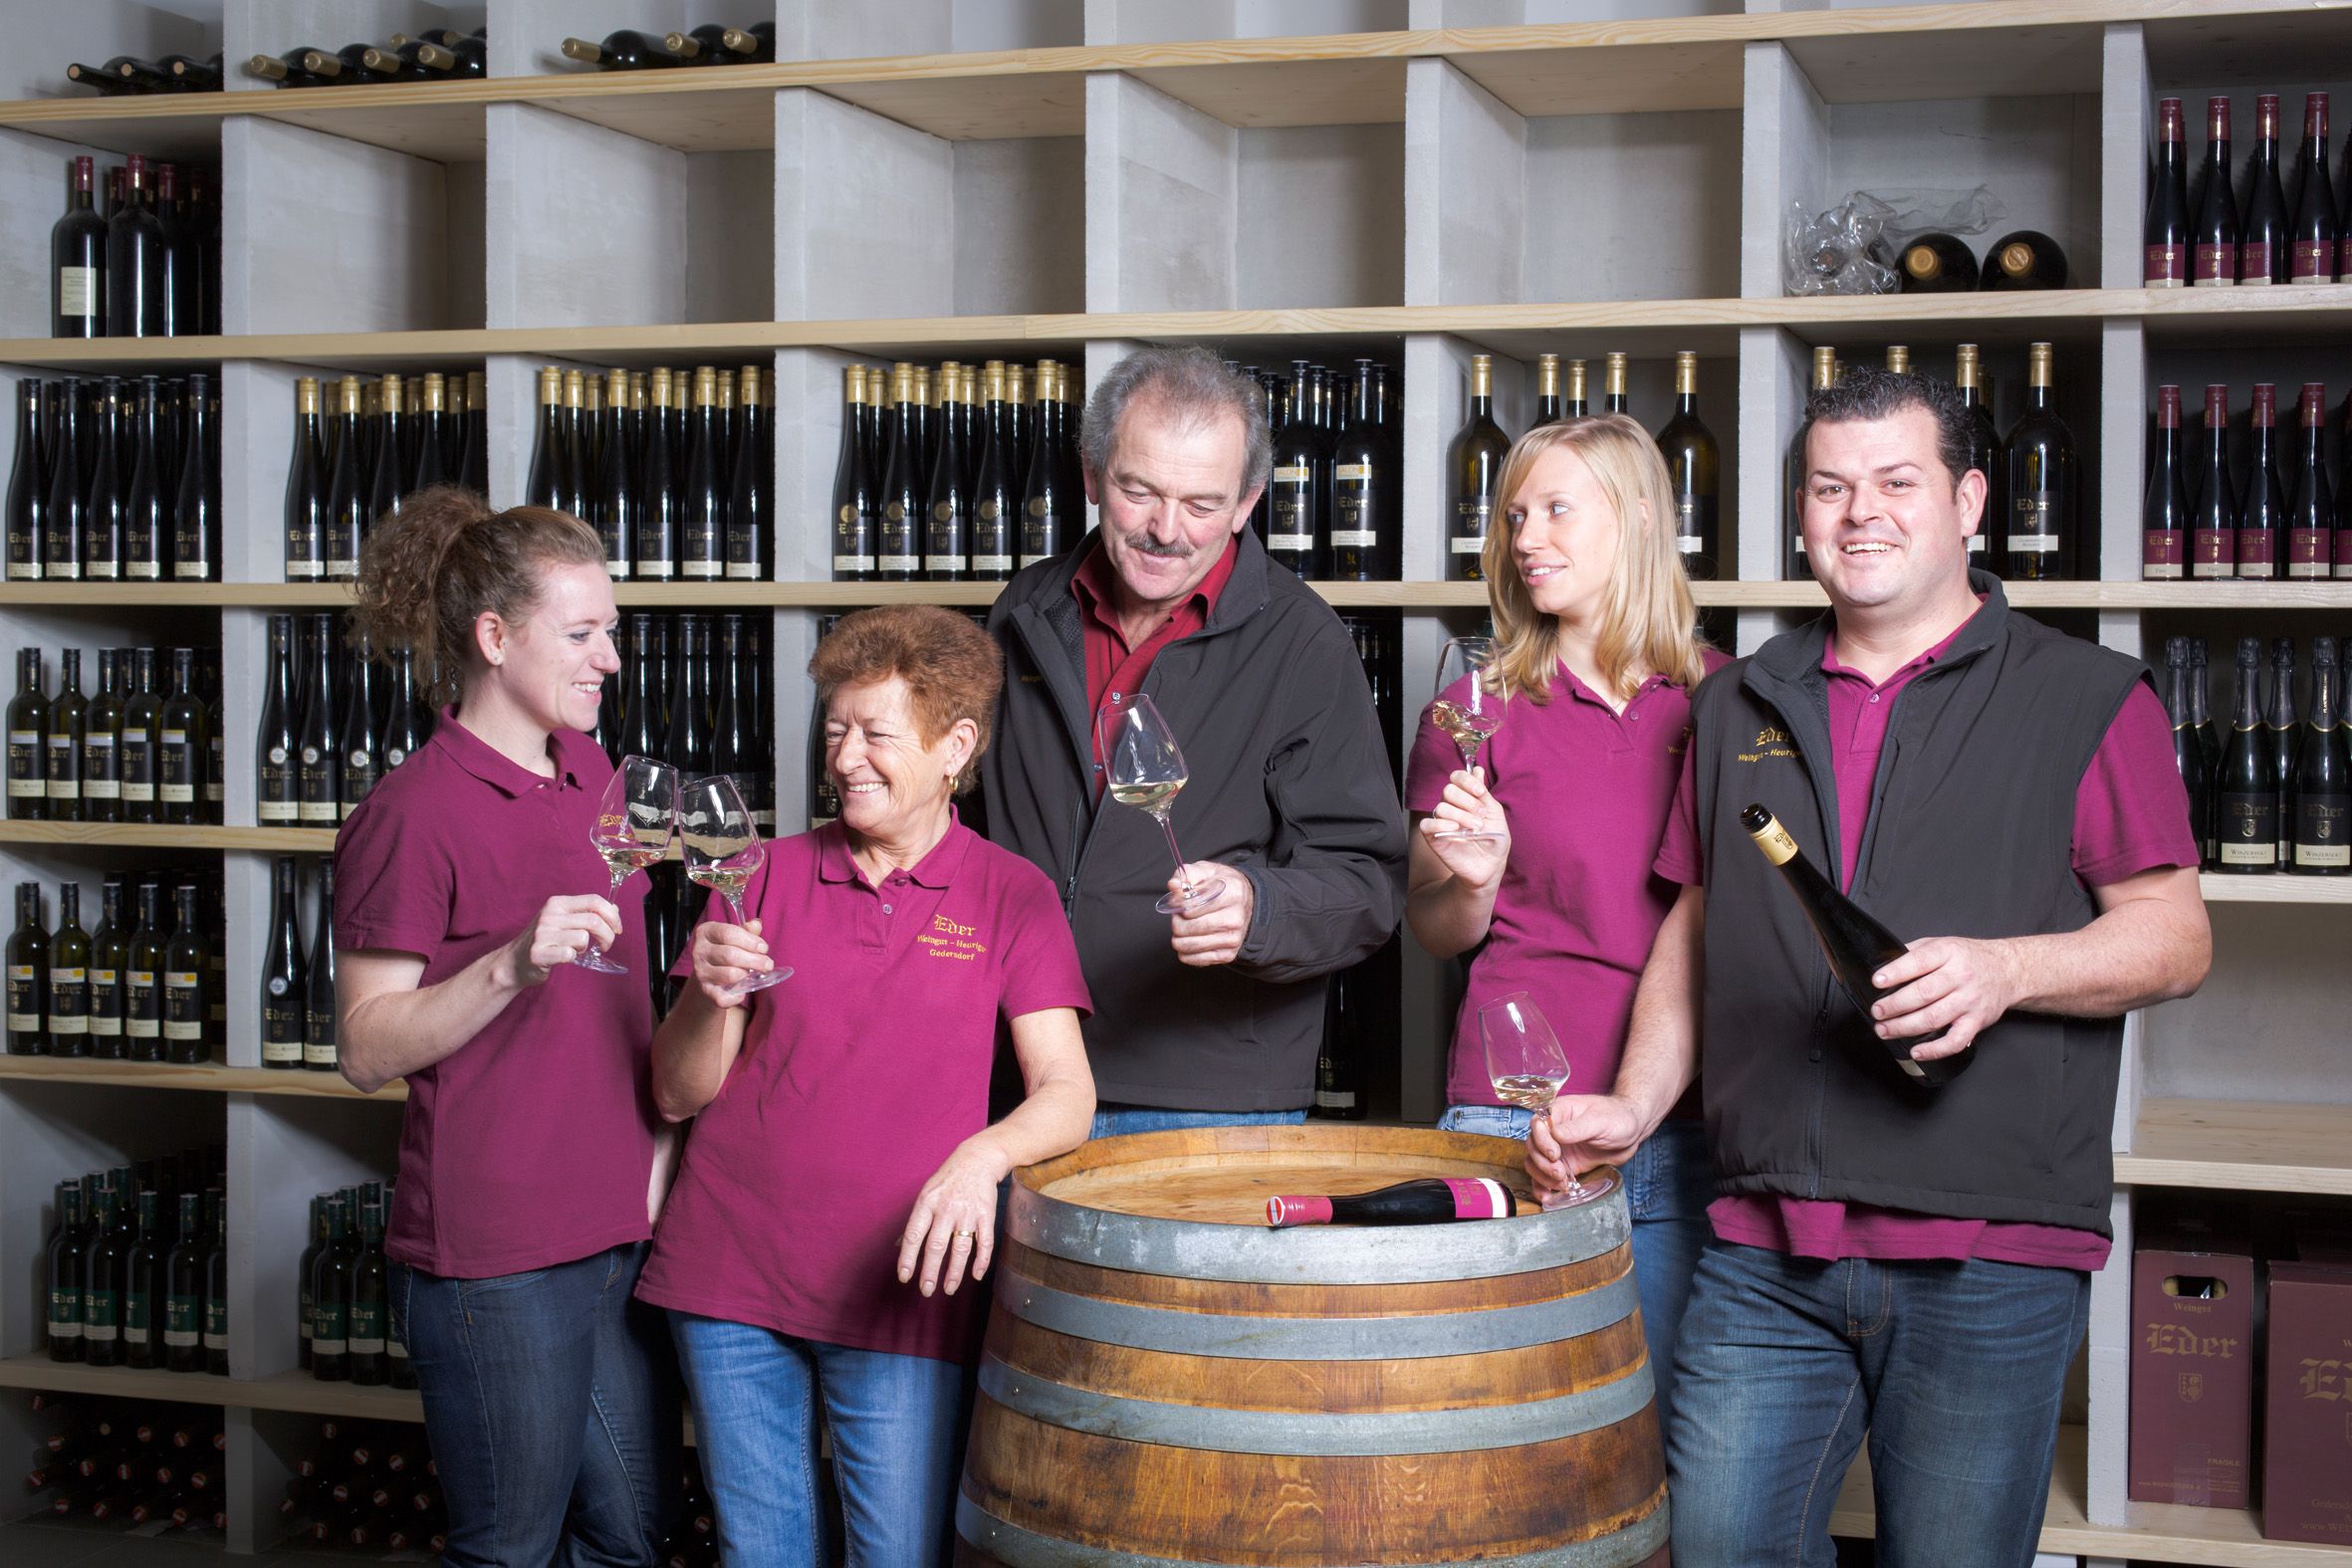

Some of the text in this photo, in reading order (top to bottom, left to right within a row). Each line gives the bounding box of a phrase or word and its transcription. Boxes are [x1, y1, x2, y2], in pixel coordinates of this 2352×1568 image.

[1276, 500, 1304, 512] Eder
[1338, 496, 1369, 508] Eder
[2016, 498, 2049, 511] Eder
[838, 523, 867, 535] Eder
[883, 523, 911, 535] Eder
[934, 914, 977, 937] Eder
[917, 934, 949, 947] Weingut
[929, 948, 976, 962] Gedersdorf
[2173, 1302, 2212, 1313] Weingut
[2146, 1322, 2238, 1359] Eder
